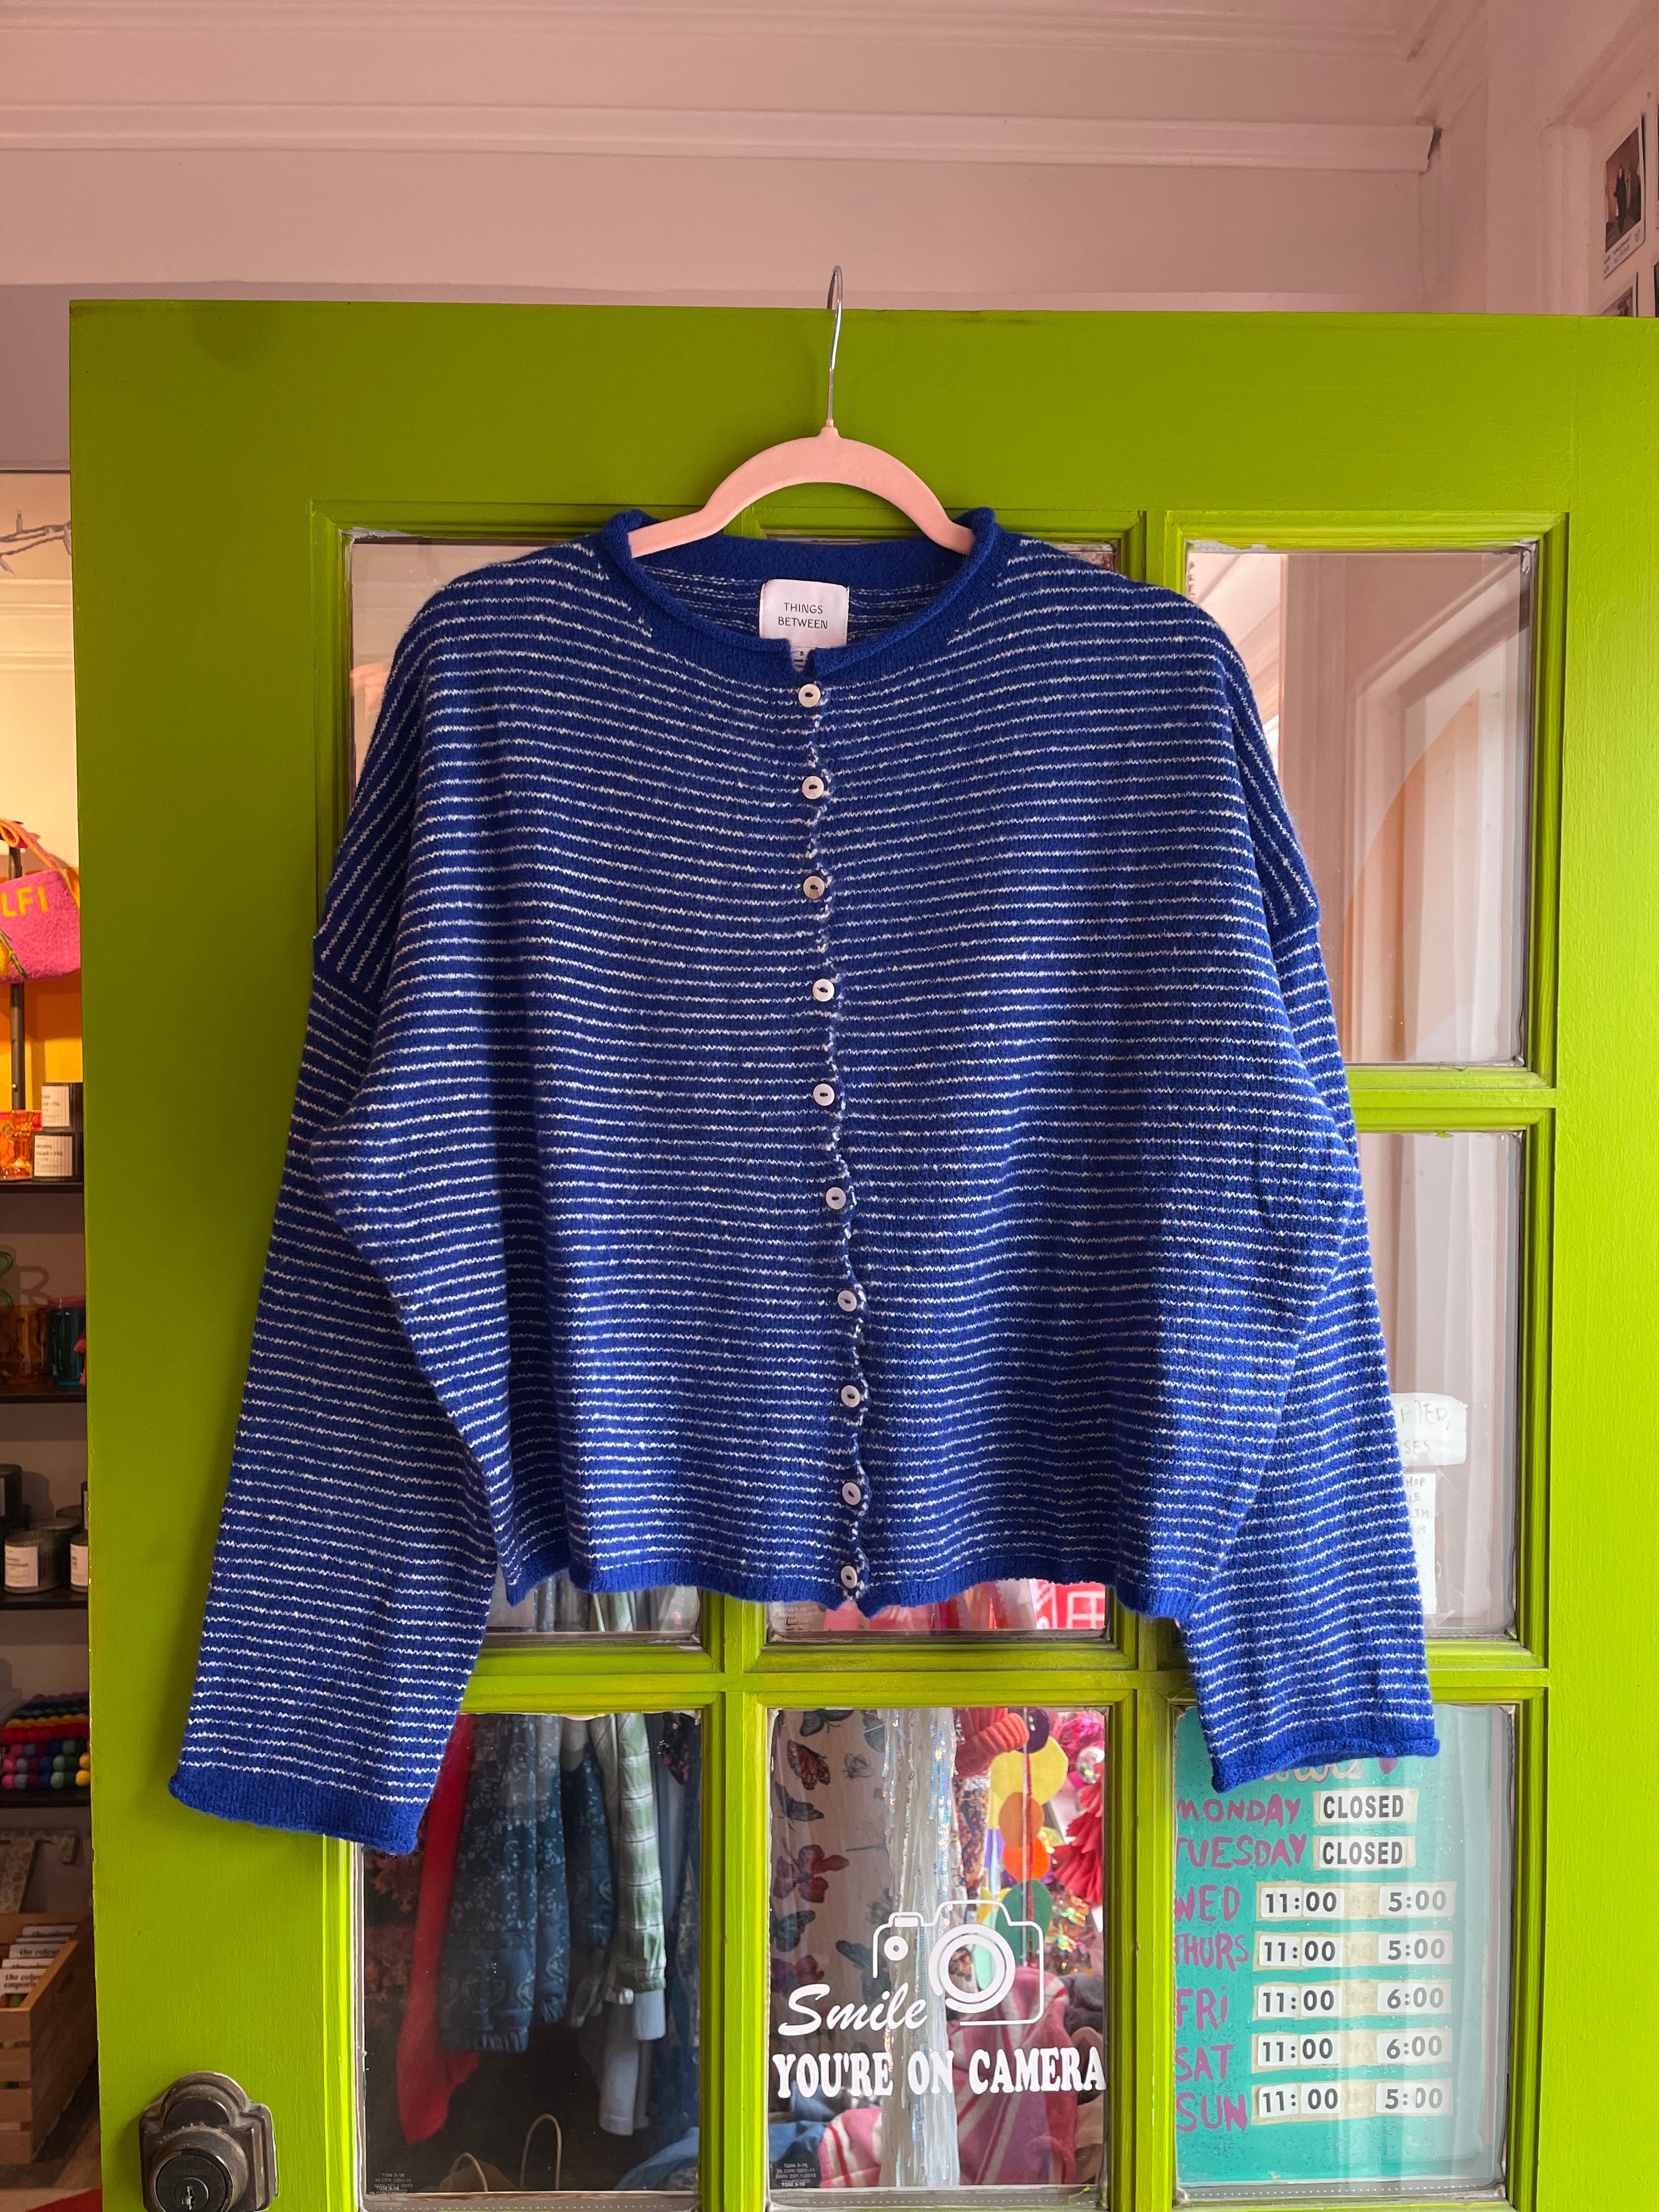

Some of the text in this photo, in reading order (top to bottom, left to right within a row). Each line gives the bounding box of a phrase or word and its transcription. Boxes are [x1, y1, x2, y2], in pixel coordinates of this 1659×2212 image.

[778, 617, 828, 629] BETWEEN
[783, 602, 823, 614] THINGS
[1176, 1793, 1404, 1827] MONDAY CLOSED
[1323, 1840, 1403, 1866] CLOSED
[1175, 1885, 1447, 1922] WED 11:00 5:00
[1264, 1940, 1335, 1962] 11:00
[1387, 1938, 1445, 1960] 5:00
[778, 1983, 928, 2036] Smile
[1263, 1990, 1334, 2013] 11:00
[1387, 1987, 1444, 2009] 6:00
[772, 2047, 1107, 2098] YOU'RE ON CAMERA
[1176, 2035, 1442, 2082] SAT 11:00 6:00
[1176, 2087, 1442, 2132] SUN 11:00 5:00
